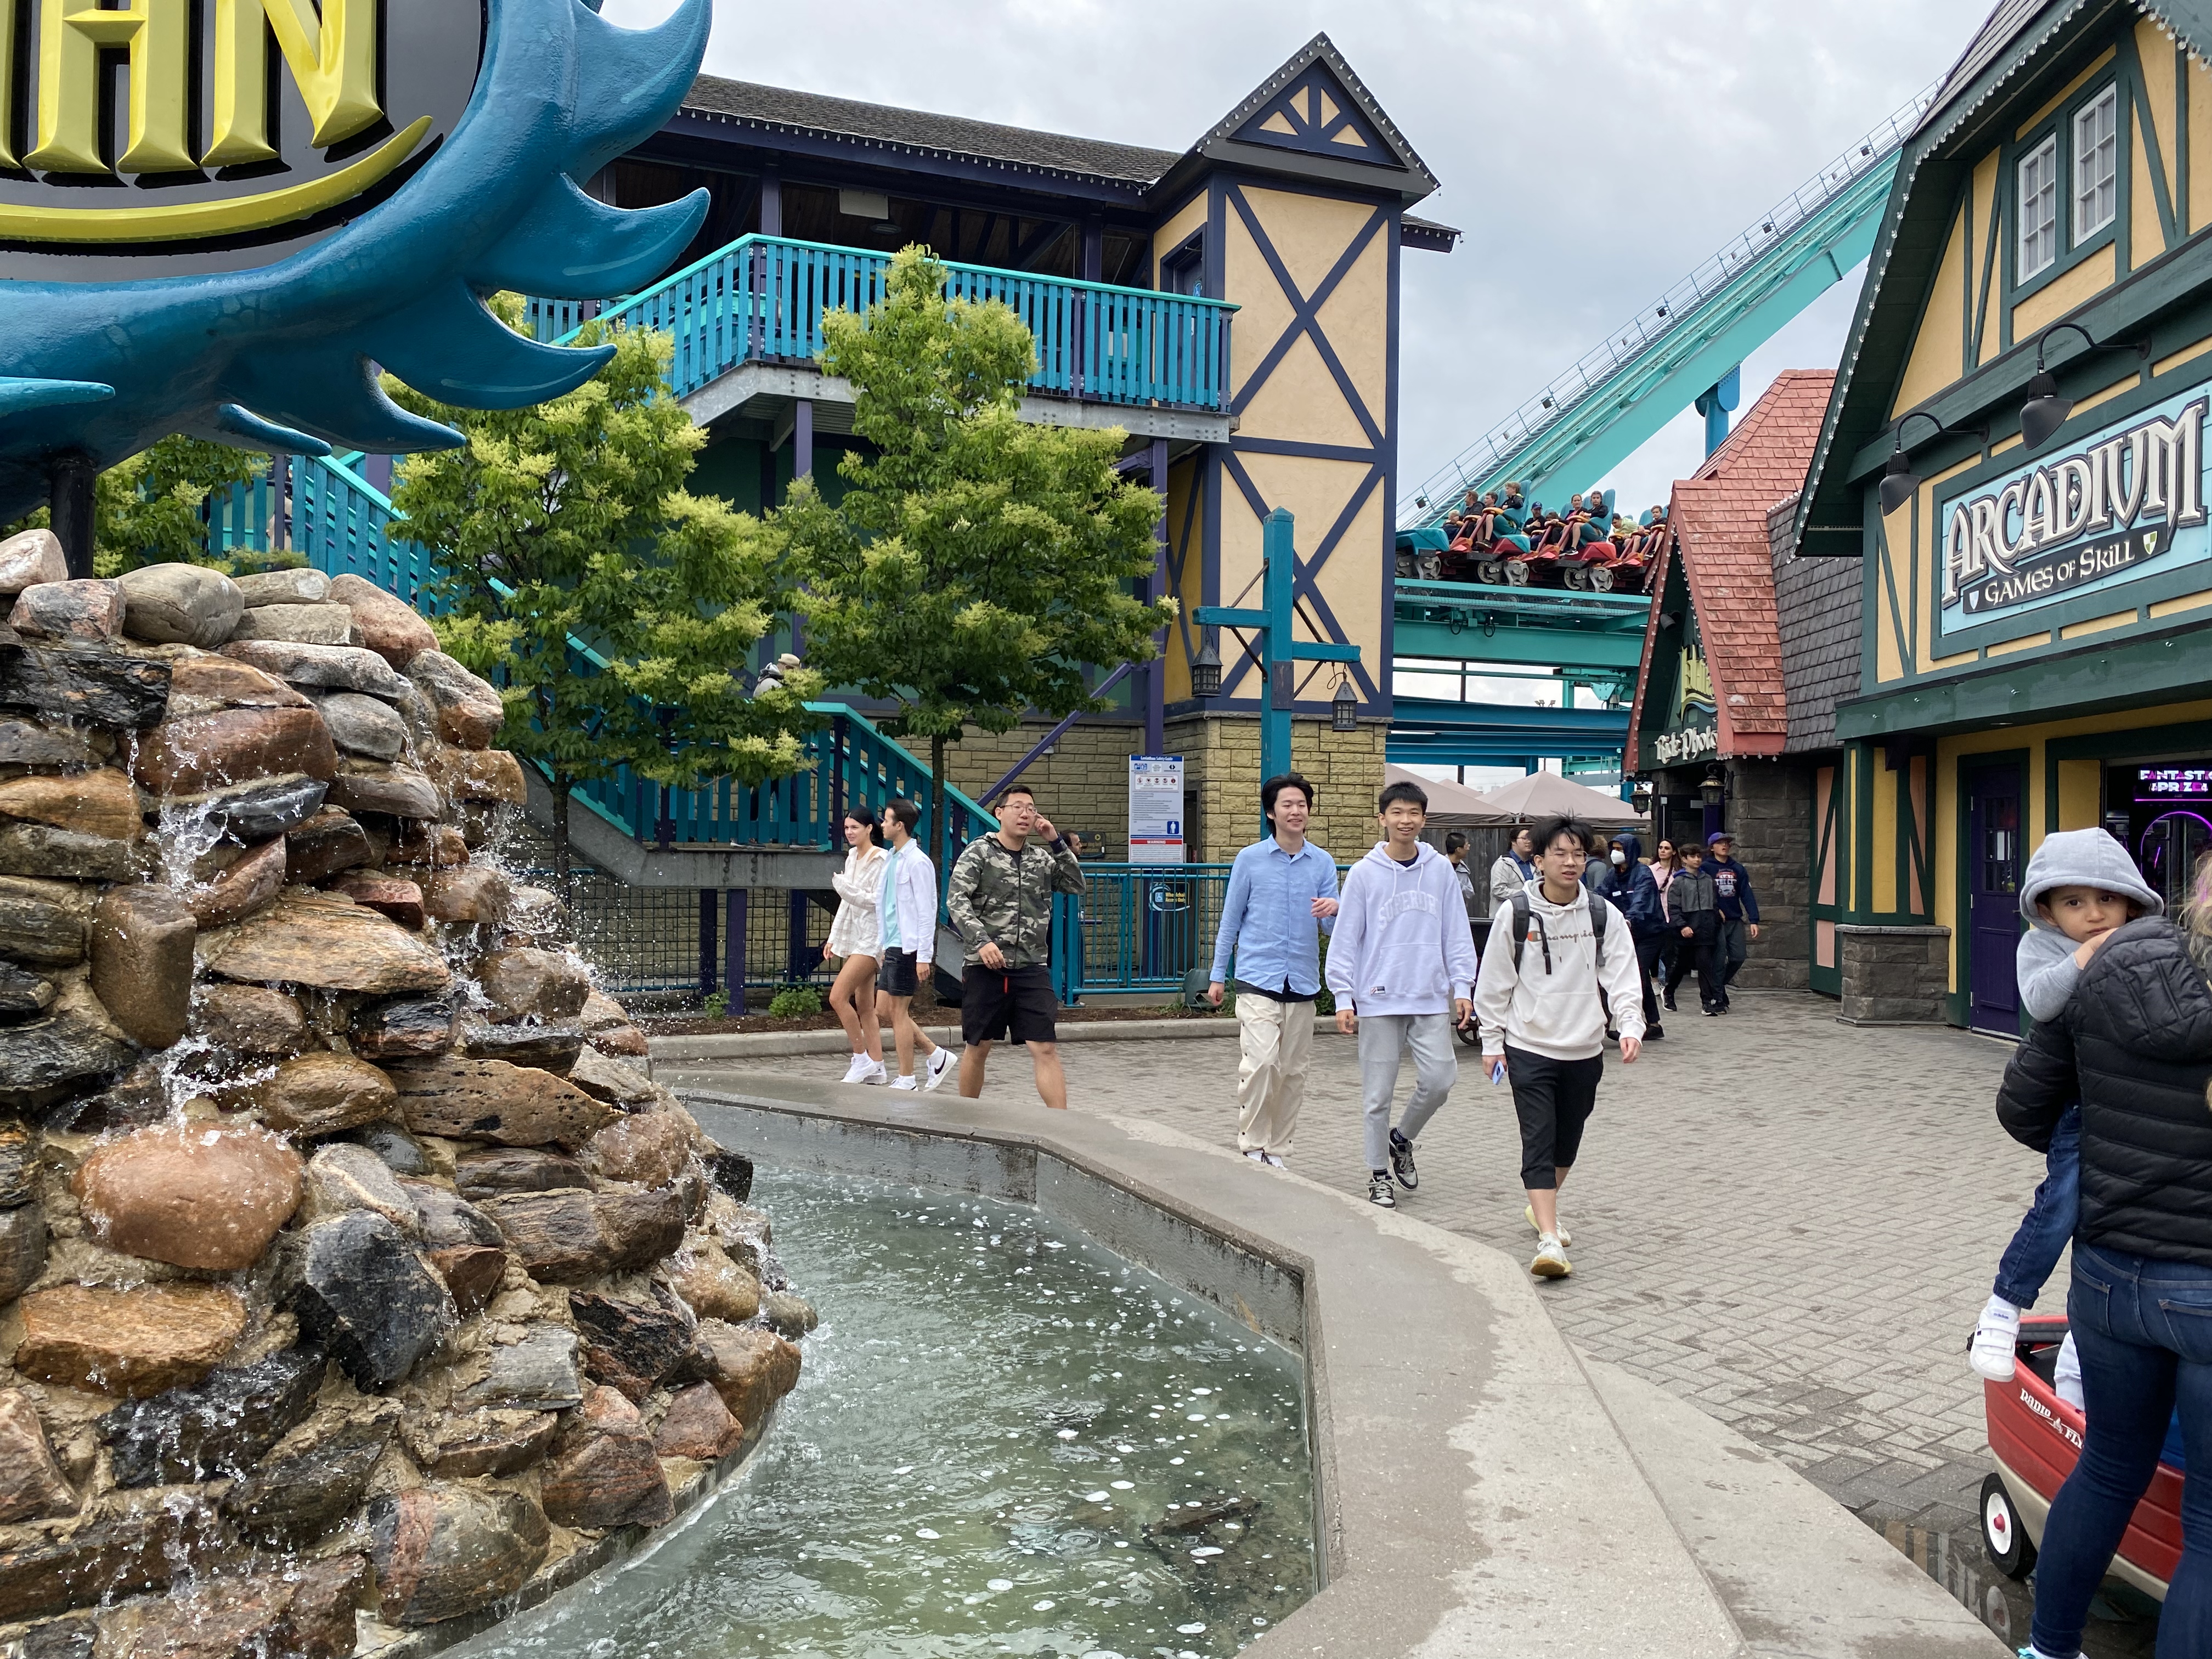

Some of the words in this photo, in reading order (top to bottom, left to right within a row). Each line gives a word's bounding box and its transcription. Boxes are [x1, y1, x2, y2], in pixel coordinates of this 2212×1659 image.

[2057, 559, 2077, 582] OF
[2019, 1387, 2052, 1418] RADIO
[2064, 1428, 2084, 1449] FLY
